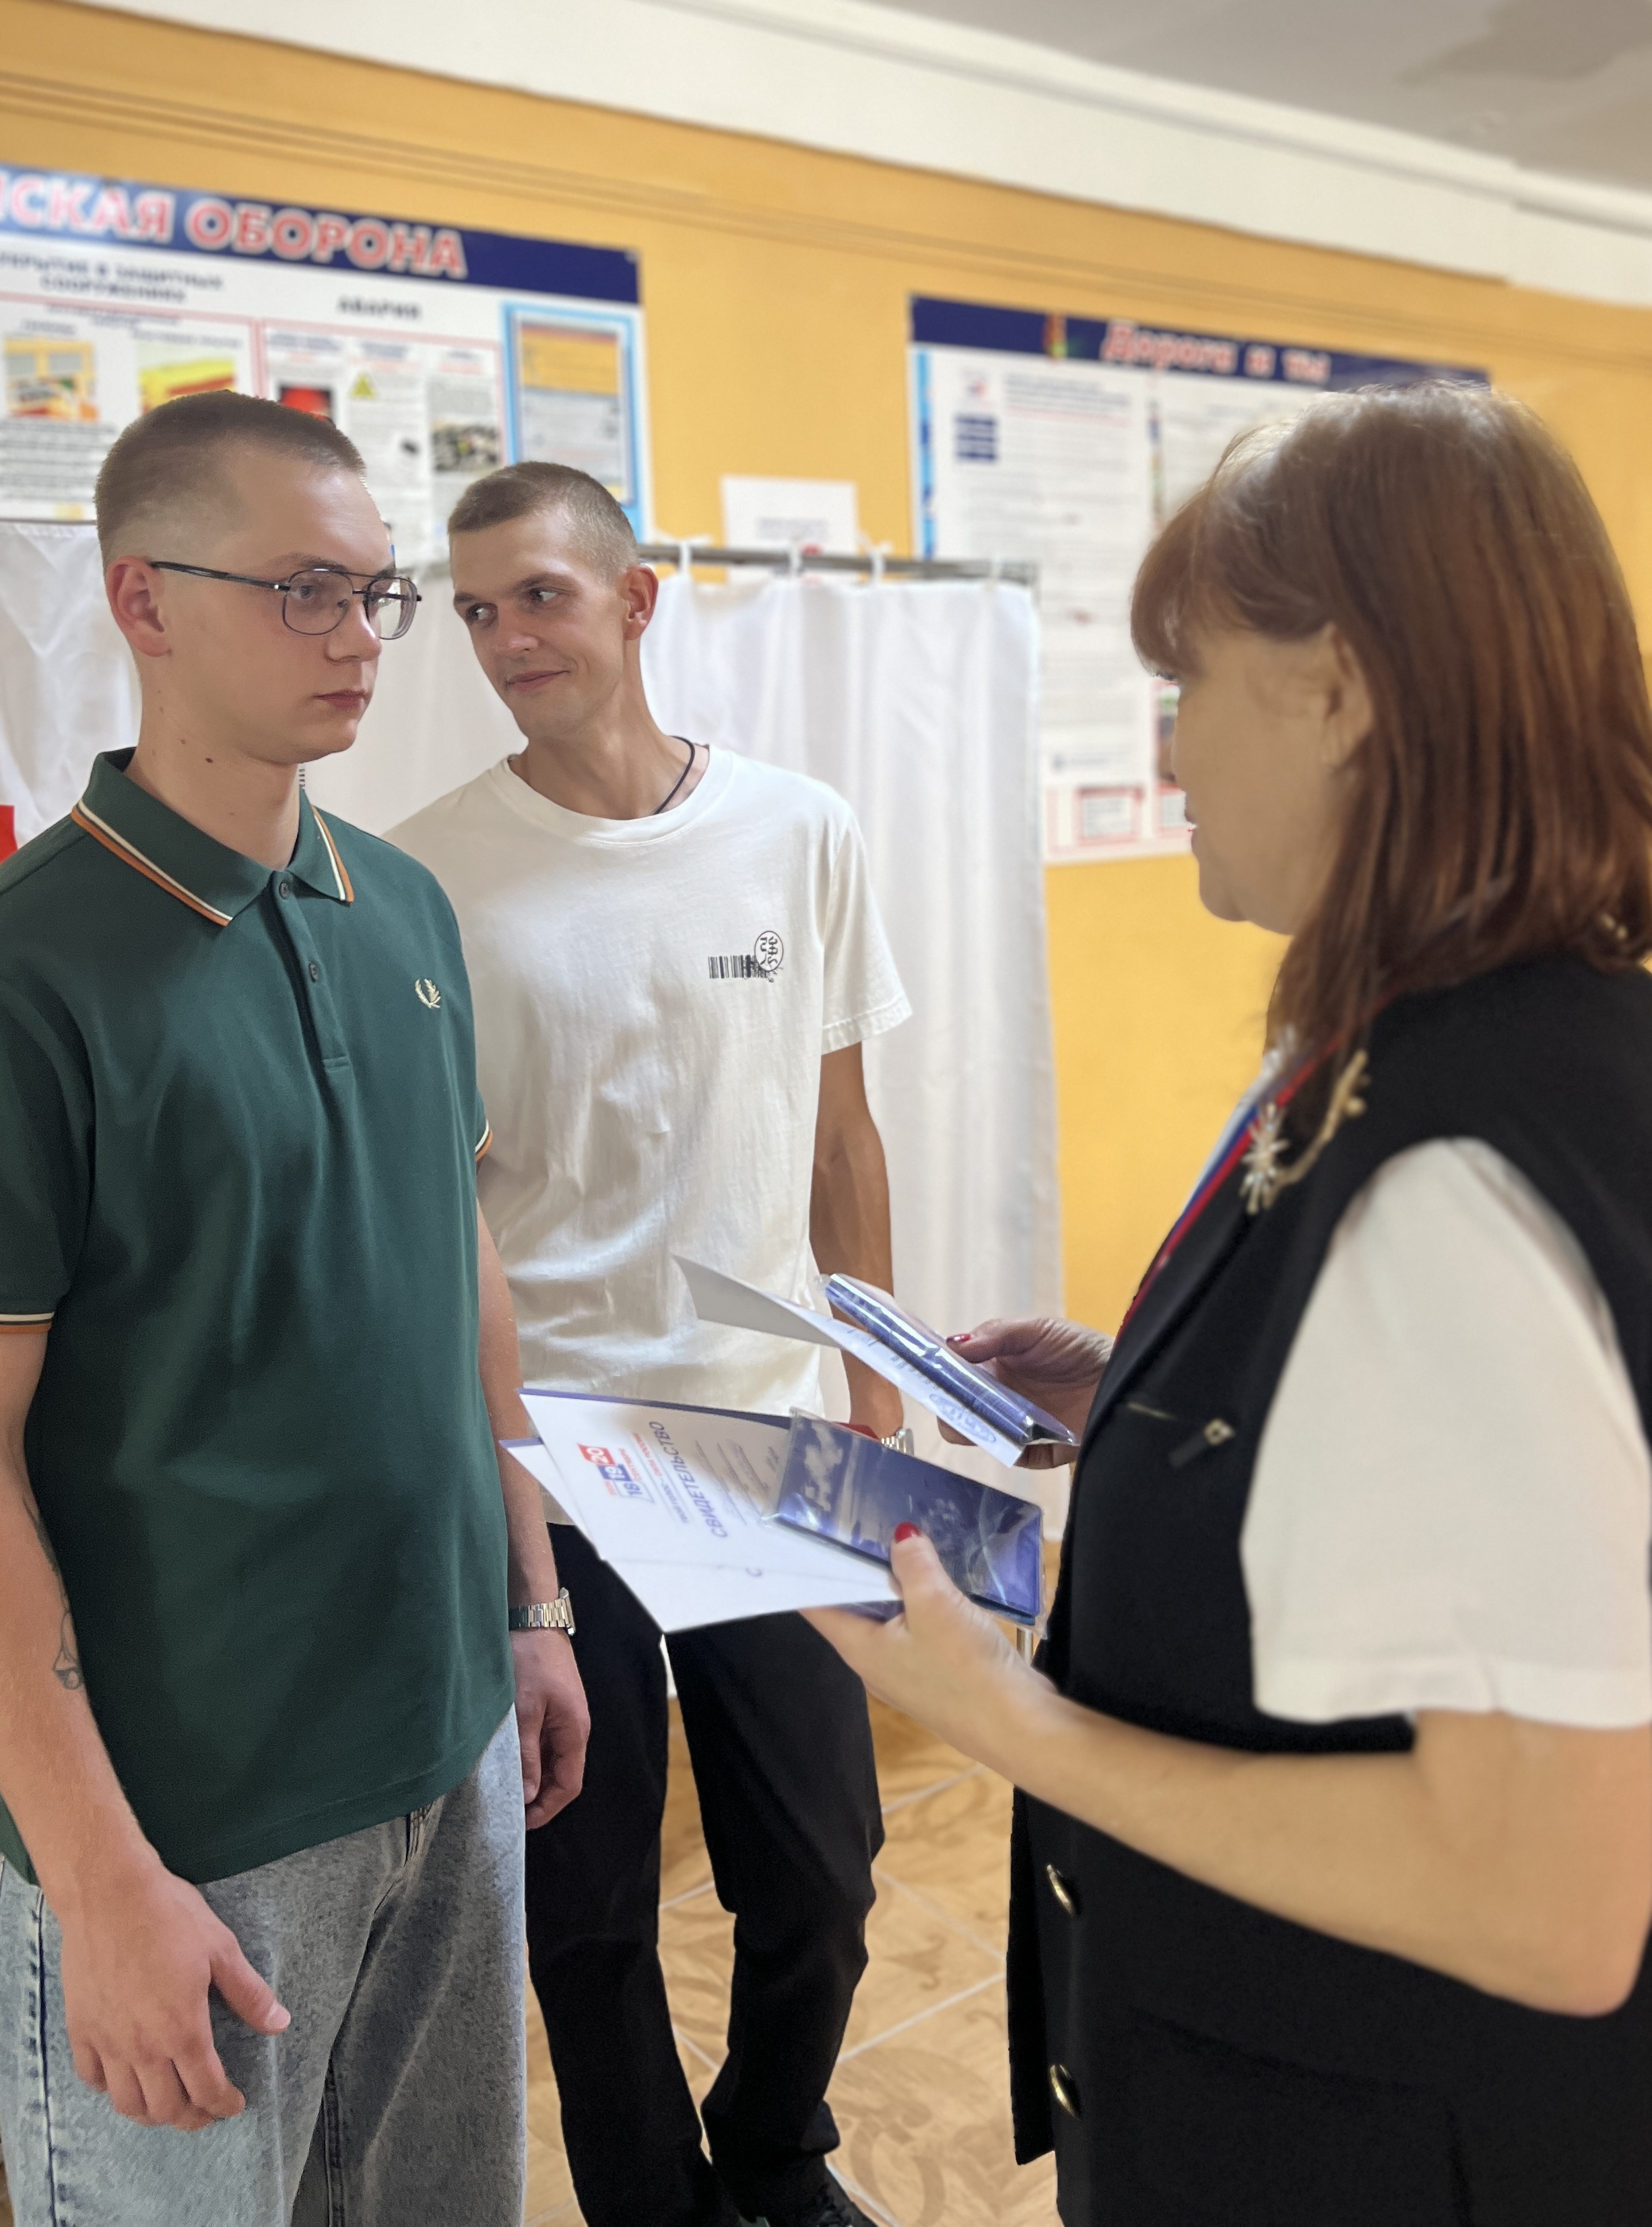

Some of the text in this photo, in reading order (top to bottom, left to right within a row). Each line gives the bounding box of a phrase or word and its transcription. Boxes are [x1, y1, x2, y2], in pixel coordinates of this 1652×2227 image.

[185, 197, 468, 280] ОБОРОНА
[586, 1447, 643, 1495] 18 19 20
[649, 1421, 728, 1538] СВИДЕТЕЛЬСТВО
